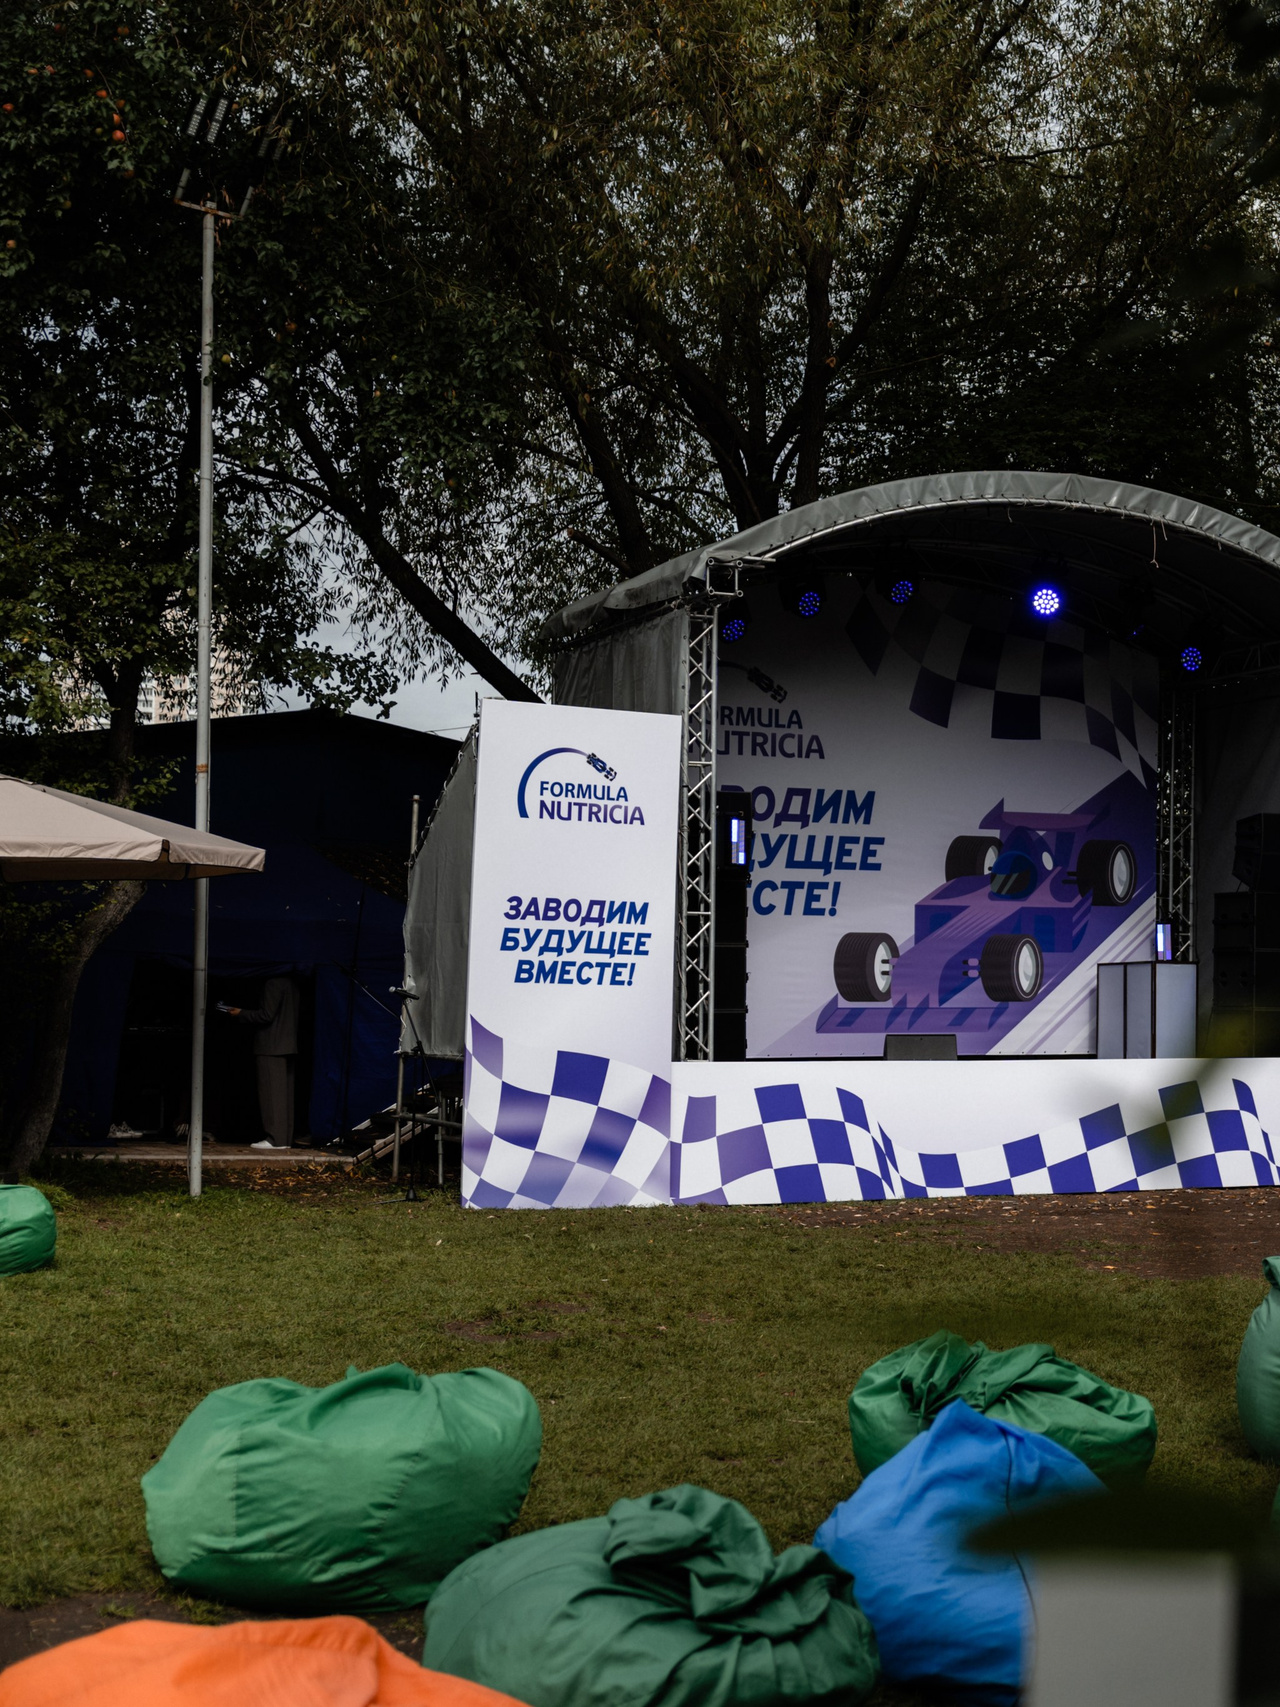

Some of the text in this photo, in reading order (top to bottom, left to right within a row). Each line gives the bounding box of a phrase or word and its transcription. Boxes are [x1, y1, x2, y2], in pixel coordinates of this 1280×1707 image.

[539, 780, 629, 802] FORMULA
[538, 799, 646, 826] NUTRICIA
[503, 895, 649, 928] ЗАВОДИМ
[500, 927, 652, 959] БУДУЩЕЕ
[513, 959, 637, 987] ВМЕСТЕ!
